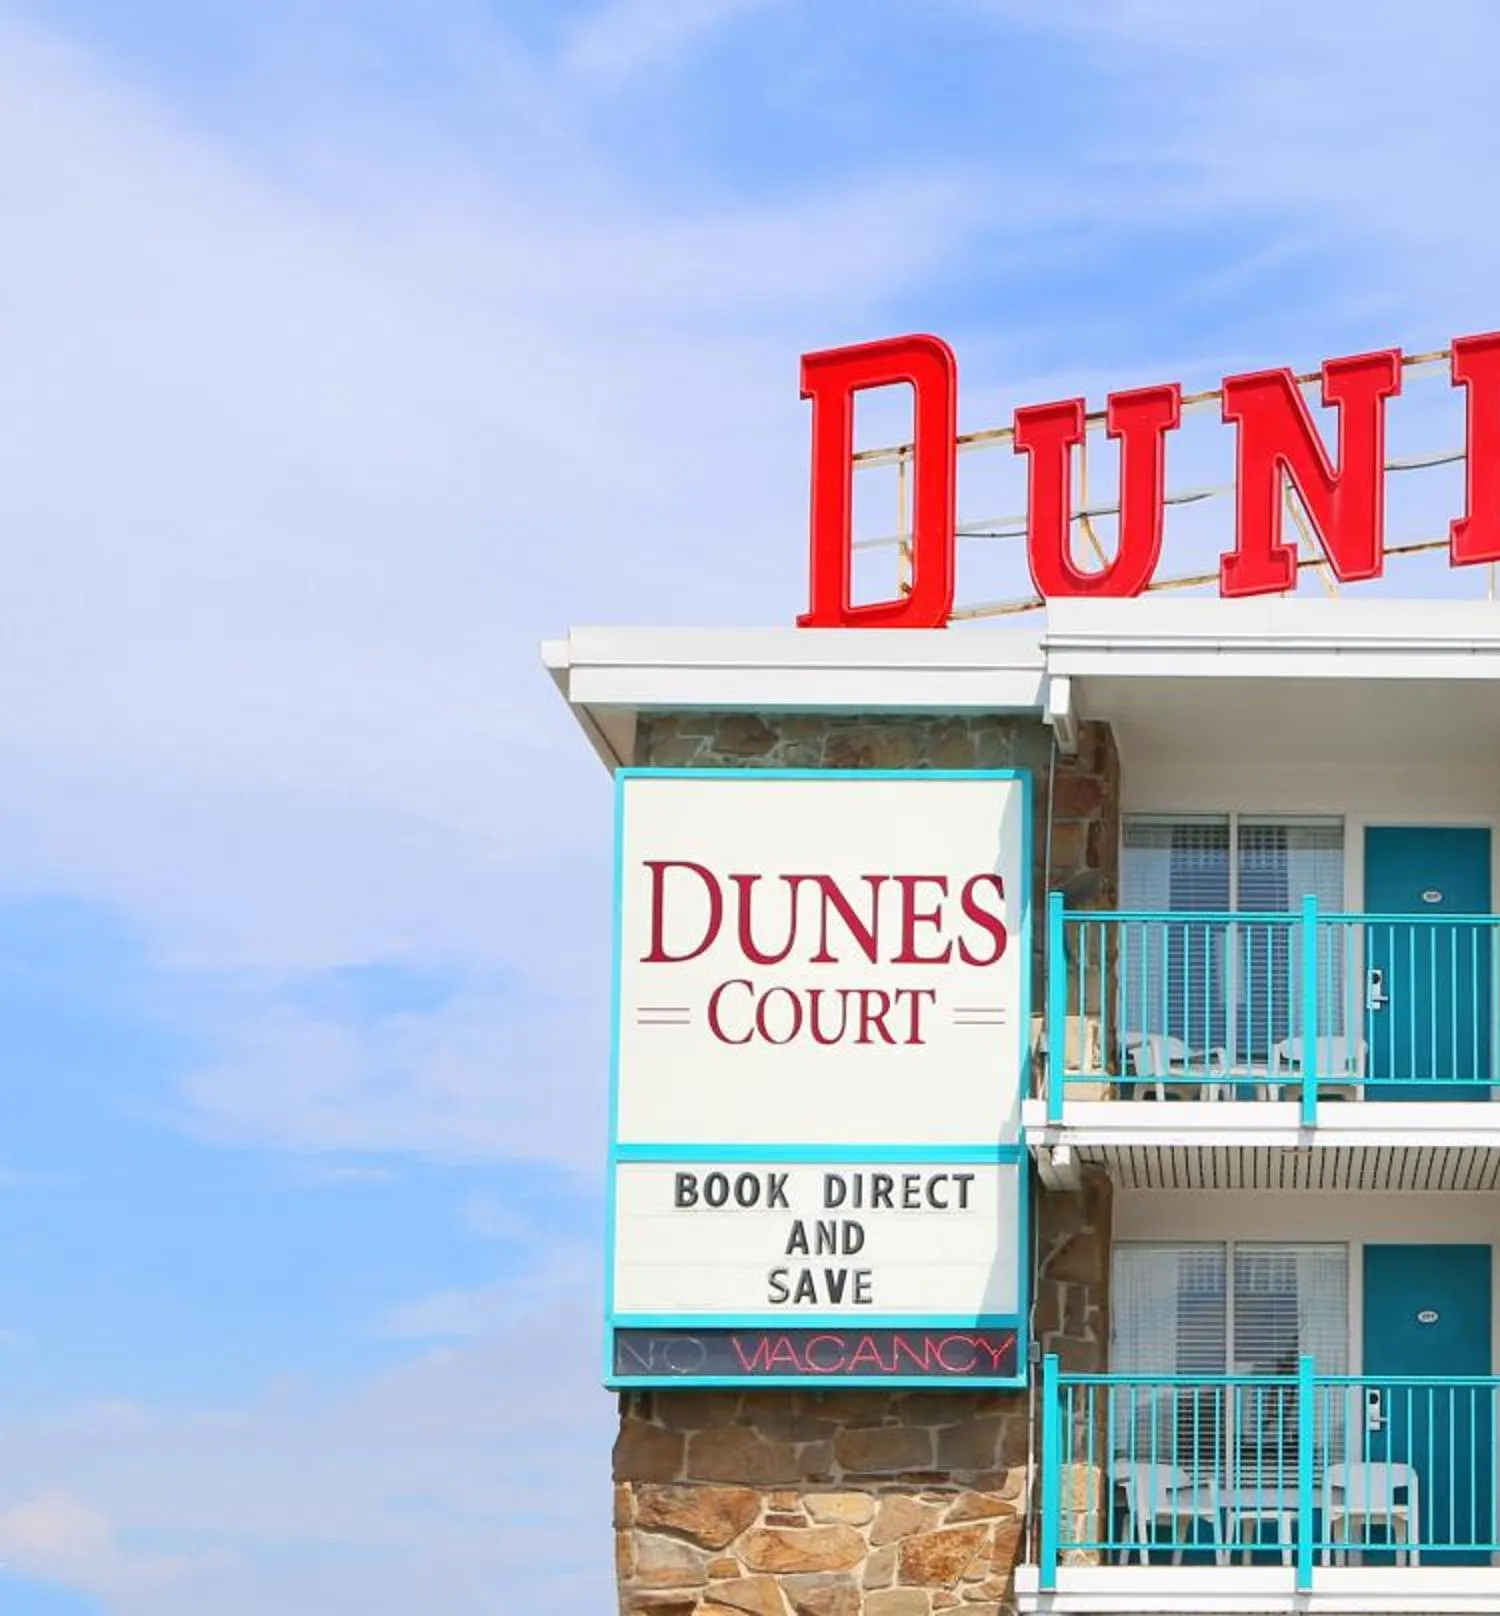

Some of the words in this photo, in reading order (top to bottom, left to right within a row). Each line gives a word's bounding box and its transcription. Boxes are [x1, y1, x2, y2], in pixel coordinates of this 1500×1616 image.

[640, 861, 1008, 967] DUNES
[707, 979, 936, 1045] COURT
[674, 1172, 790, 1209] BOOK
[824, 1173, 974, 1209] DIRECT
[785, 1220, 865, 1255] AND
[767, 1268, 873, 1305] SAVE
[617, 1336, 707, 1374] NO
[732, 1335, 1016, 1373] VACANCY
